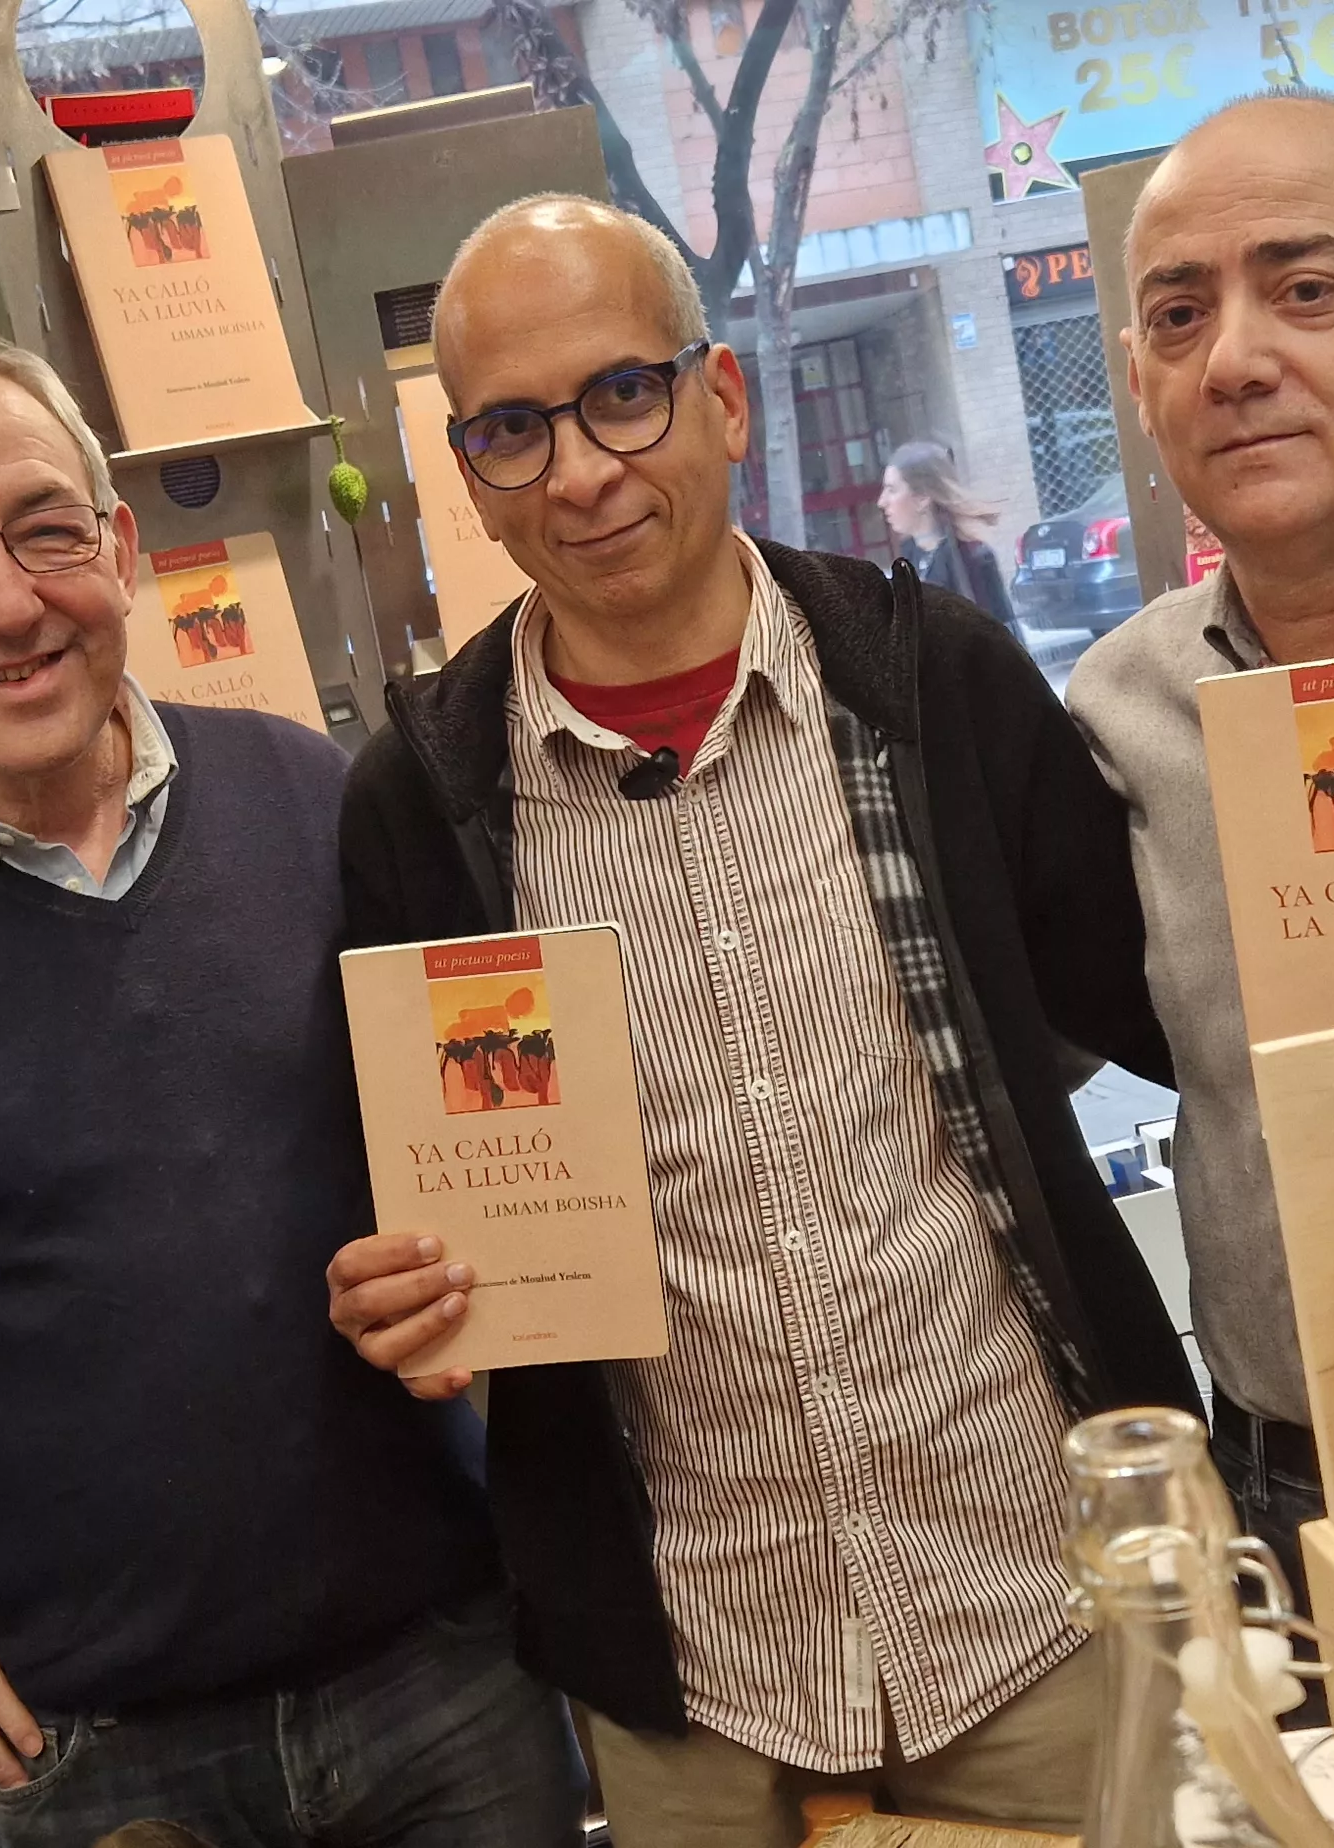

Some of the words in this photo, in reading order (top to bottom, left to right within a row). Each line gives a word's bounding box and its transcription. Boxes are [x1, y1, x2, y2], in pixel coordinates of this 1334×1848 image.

[1075, 42, 1198, 114] 25€
[113, 287, 141, 304] YA
[145, 274, 210, 301] CALLÓ
[123, 308, 149, 325] LA
[155, 298, 227, 321] LLUVIA
[171, 327, 215, 342] LIMAM
[218, 320, 266, 336] BOISHA
[448, 506, 474, 521] YA
[456, 524, 481, 541] LA
[159, 687, 187, 703] YA
[191, 670, 254, 699] CALLÓ
[1302, 680, 1317, 692] ut
[1270, 885, 1315, 909] YA
[1281, 916, 1325, 940] LA
[434, 958, 447, 969] ut
[450, 954, 493, 972] pictura
[496, 949, 531, 967] poesis
[406, 1143, 445, 1165] YA
[454, 1127, 553, 1161] CALLÓ
[416, 1172, 455, 1194] LA
[465, 1160, 574, 1189] LLUVIA
[483, 1199, 549, 1219] LIMAM
[555, 1195, 628, 1213] BOISHA
[520, 1272, 556, 1284] Moulud
[558, 1270, 592, 1282] Yeslem
